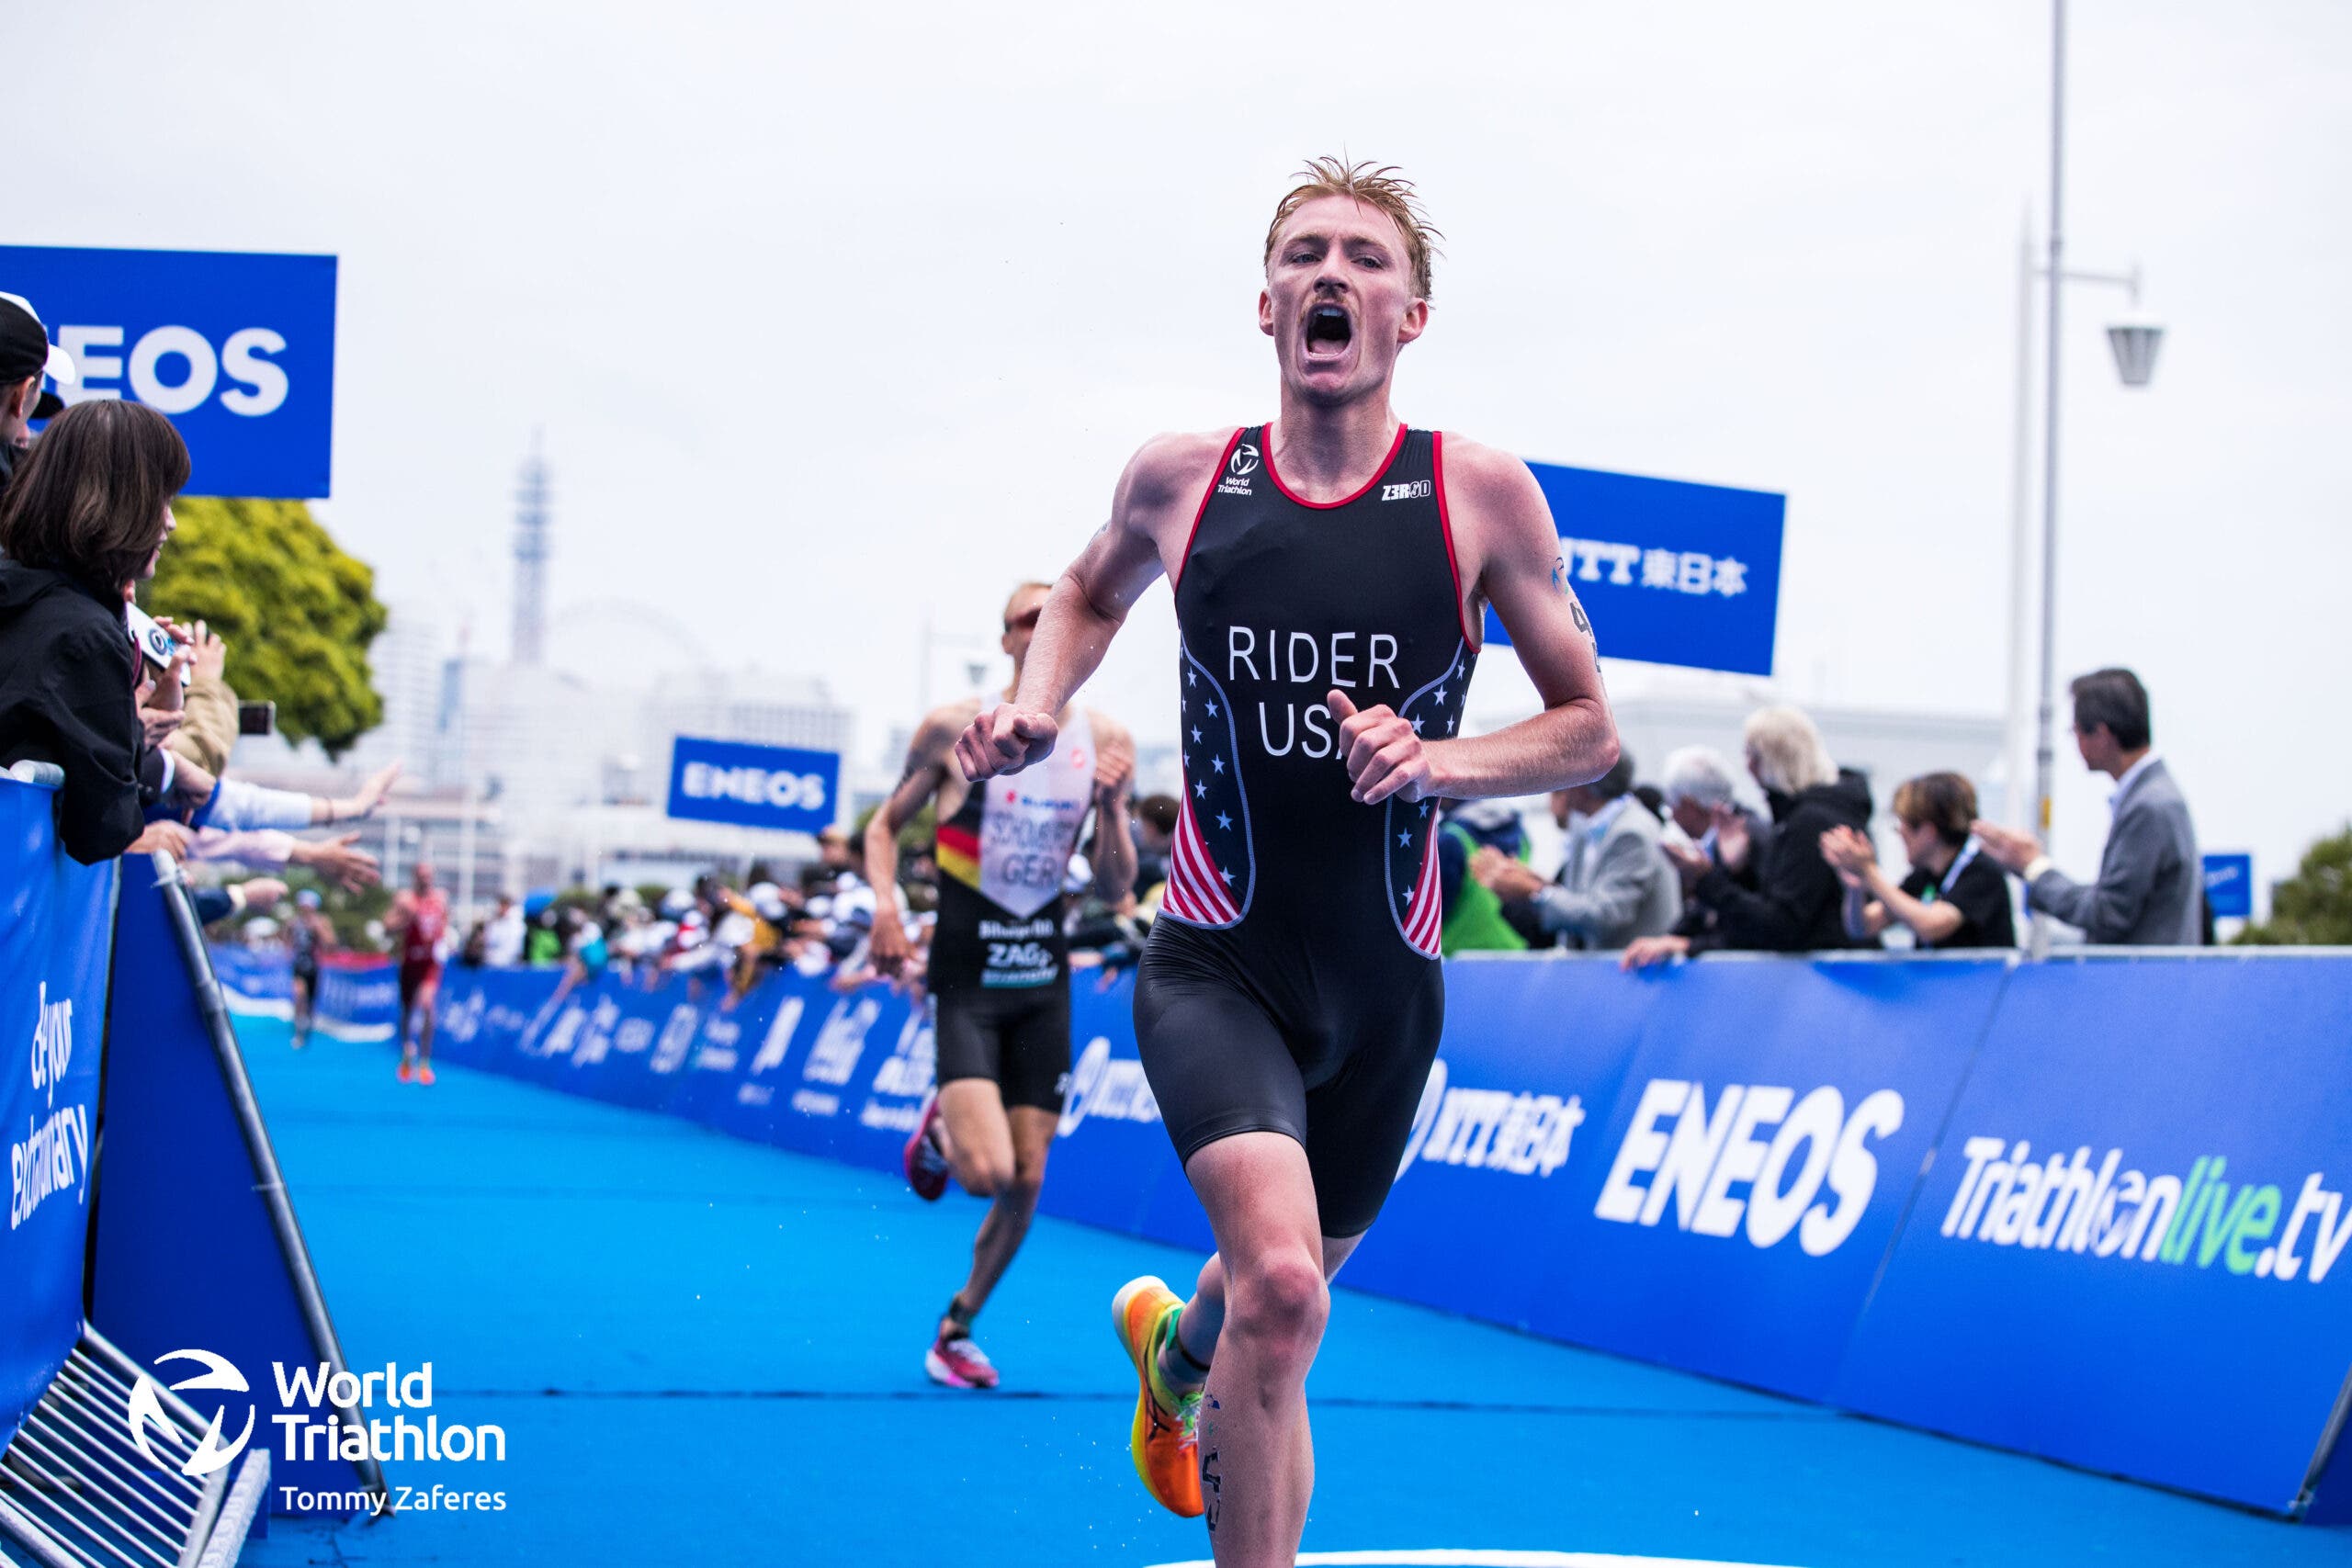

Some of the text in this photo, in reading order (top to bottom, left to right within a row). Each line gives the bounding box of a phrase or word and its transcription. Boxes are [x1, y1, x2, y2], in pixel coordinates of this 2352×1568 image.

[40, 325, 288, 417] EOS
[1217, 484, 1252, 496] Triathlon
[1225, 477, 1250, 487] World
[1228, 626, 1400, 689] RIDER
[1259, 701, 1343, 760] US
[683, 761, 825, 811] ENEOS
[1001, 853, 1058, 890] GER
[1594, 1077, 1905, 1258] ENEOS
